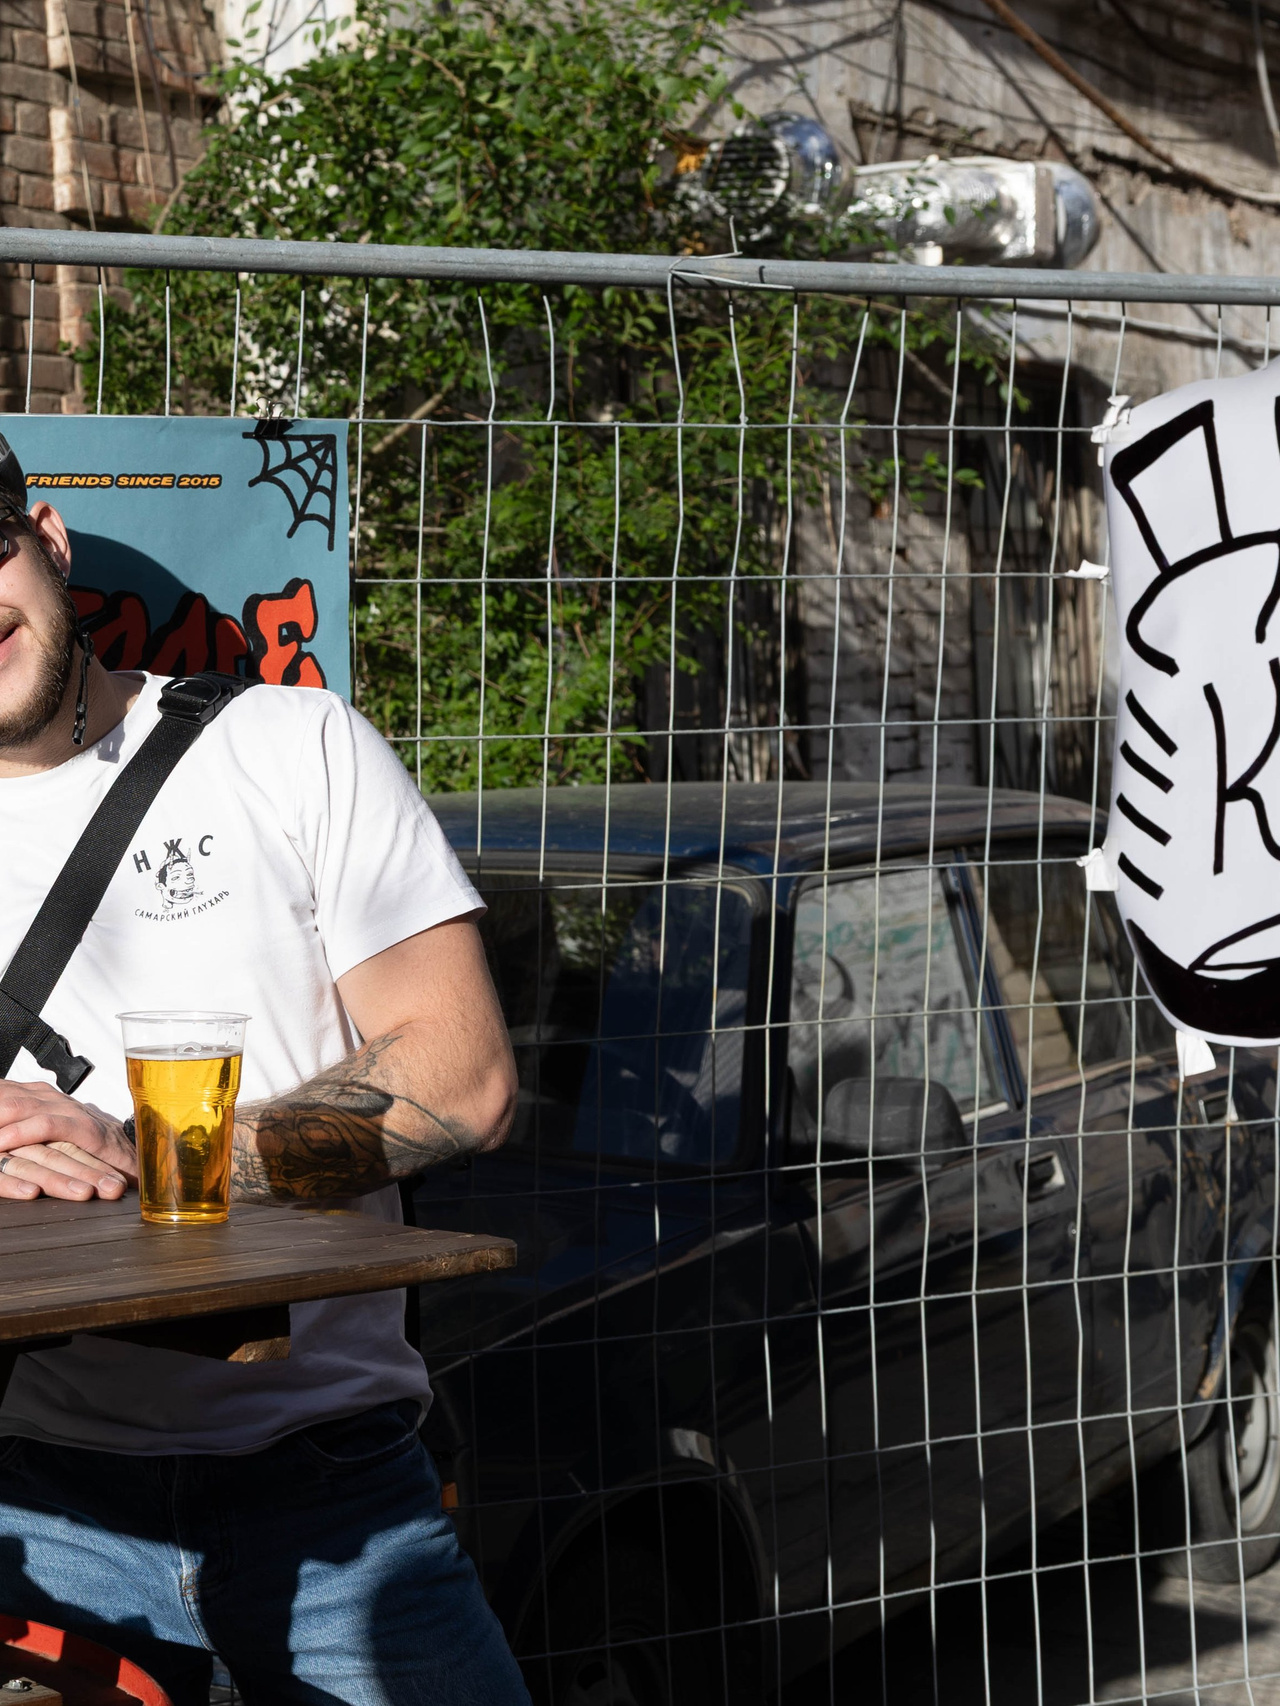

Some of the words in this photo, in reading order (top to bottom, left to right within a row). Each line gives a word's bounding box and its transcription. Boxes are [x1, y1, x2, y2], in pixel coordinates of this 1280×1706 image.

[24, 475, 113, 487] FRIENDS
[116, 475, 174, 487] SINCE
[177, 475, 221, 487] 2015
[134, 907, 190, 922] САМАРСКИЙ
[193, 889, 230, 915] ГЛУХАРЬ
